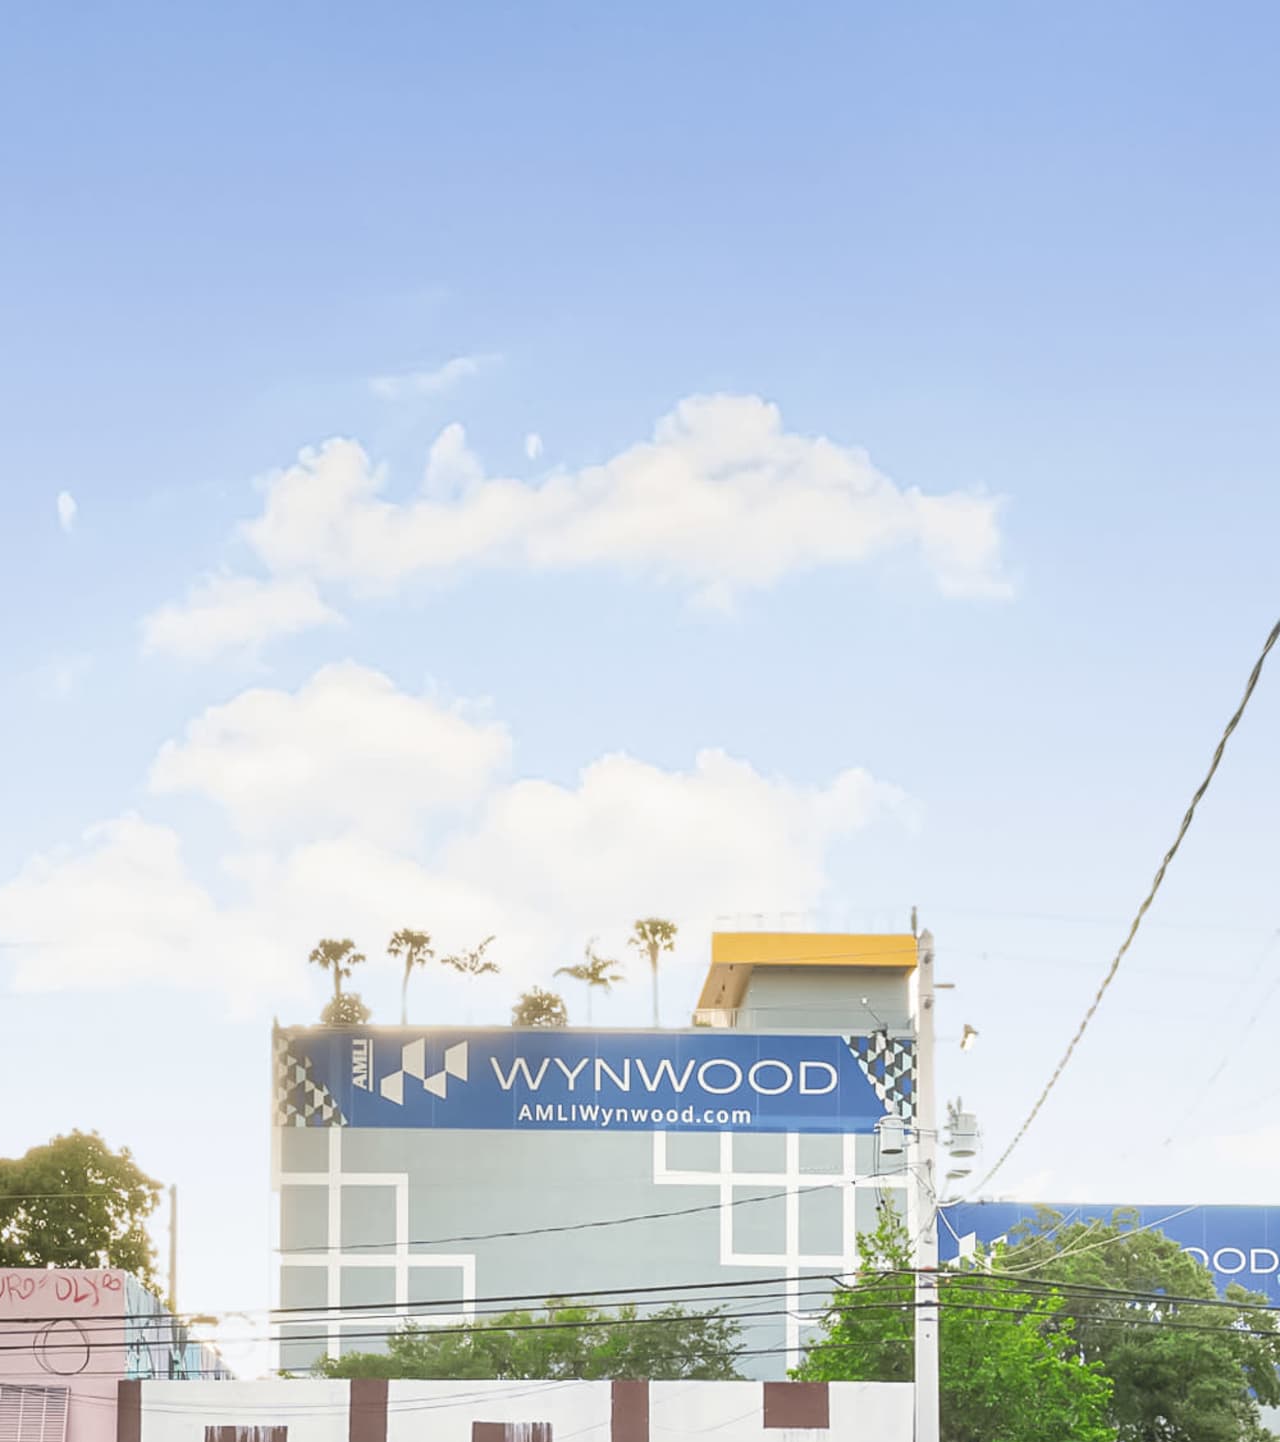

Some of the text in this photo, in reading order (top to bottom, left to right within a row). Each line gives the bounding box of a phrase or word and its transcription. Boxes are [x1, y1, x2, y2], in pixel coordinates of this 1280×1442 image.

[351, 1038, 367, 1090] AMLI
[490, 1056, 839, 1096] WYNWOOD
[518, 1103, 752, 1126] AMLIWynwood.com
